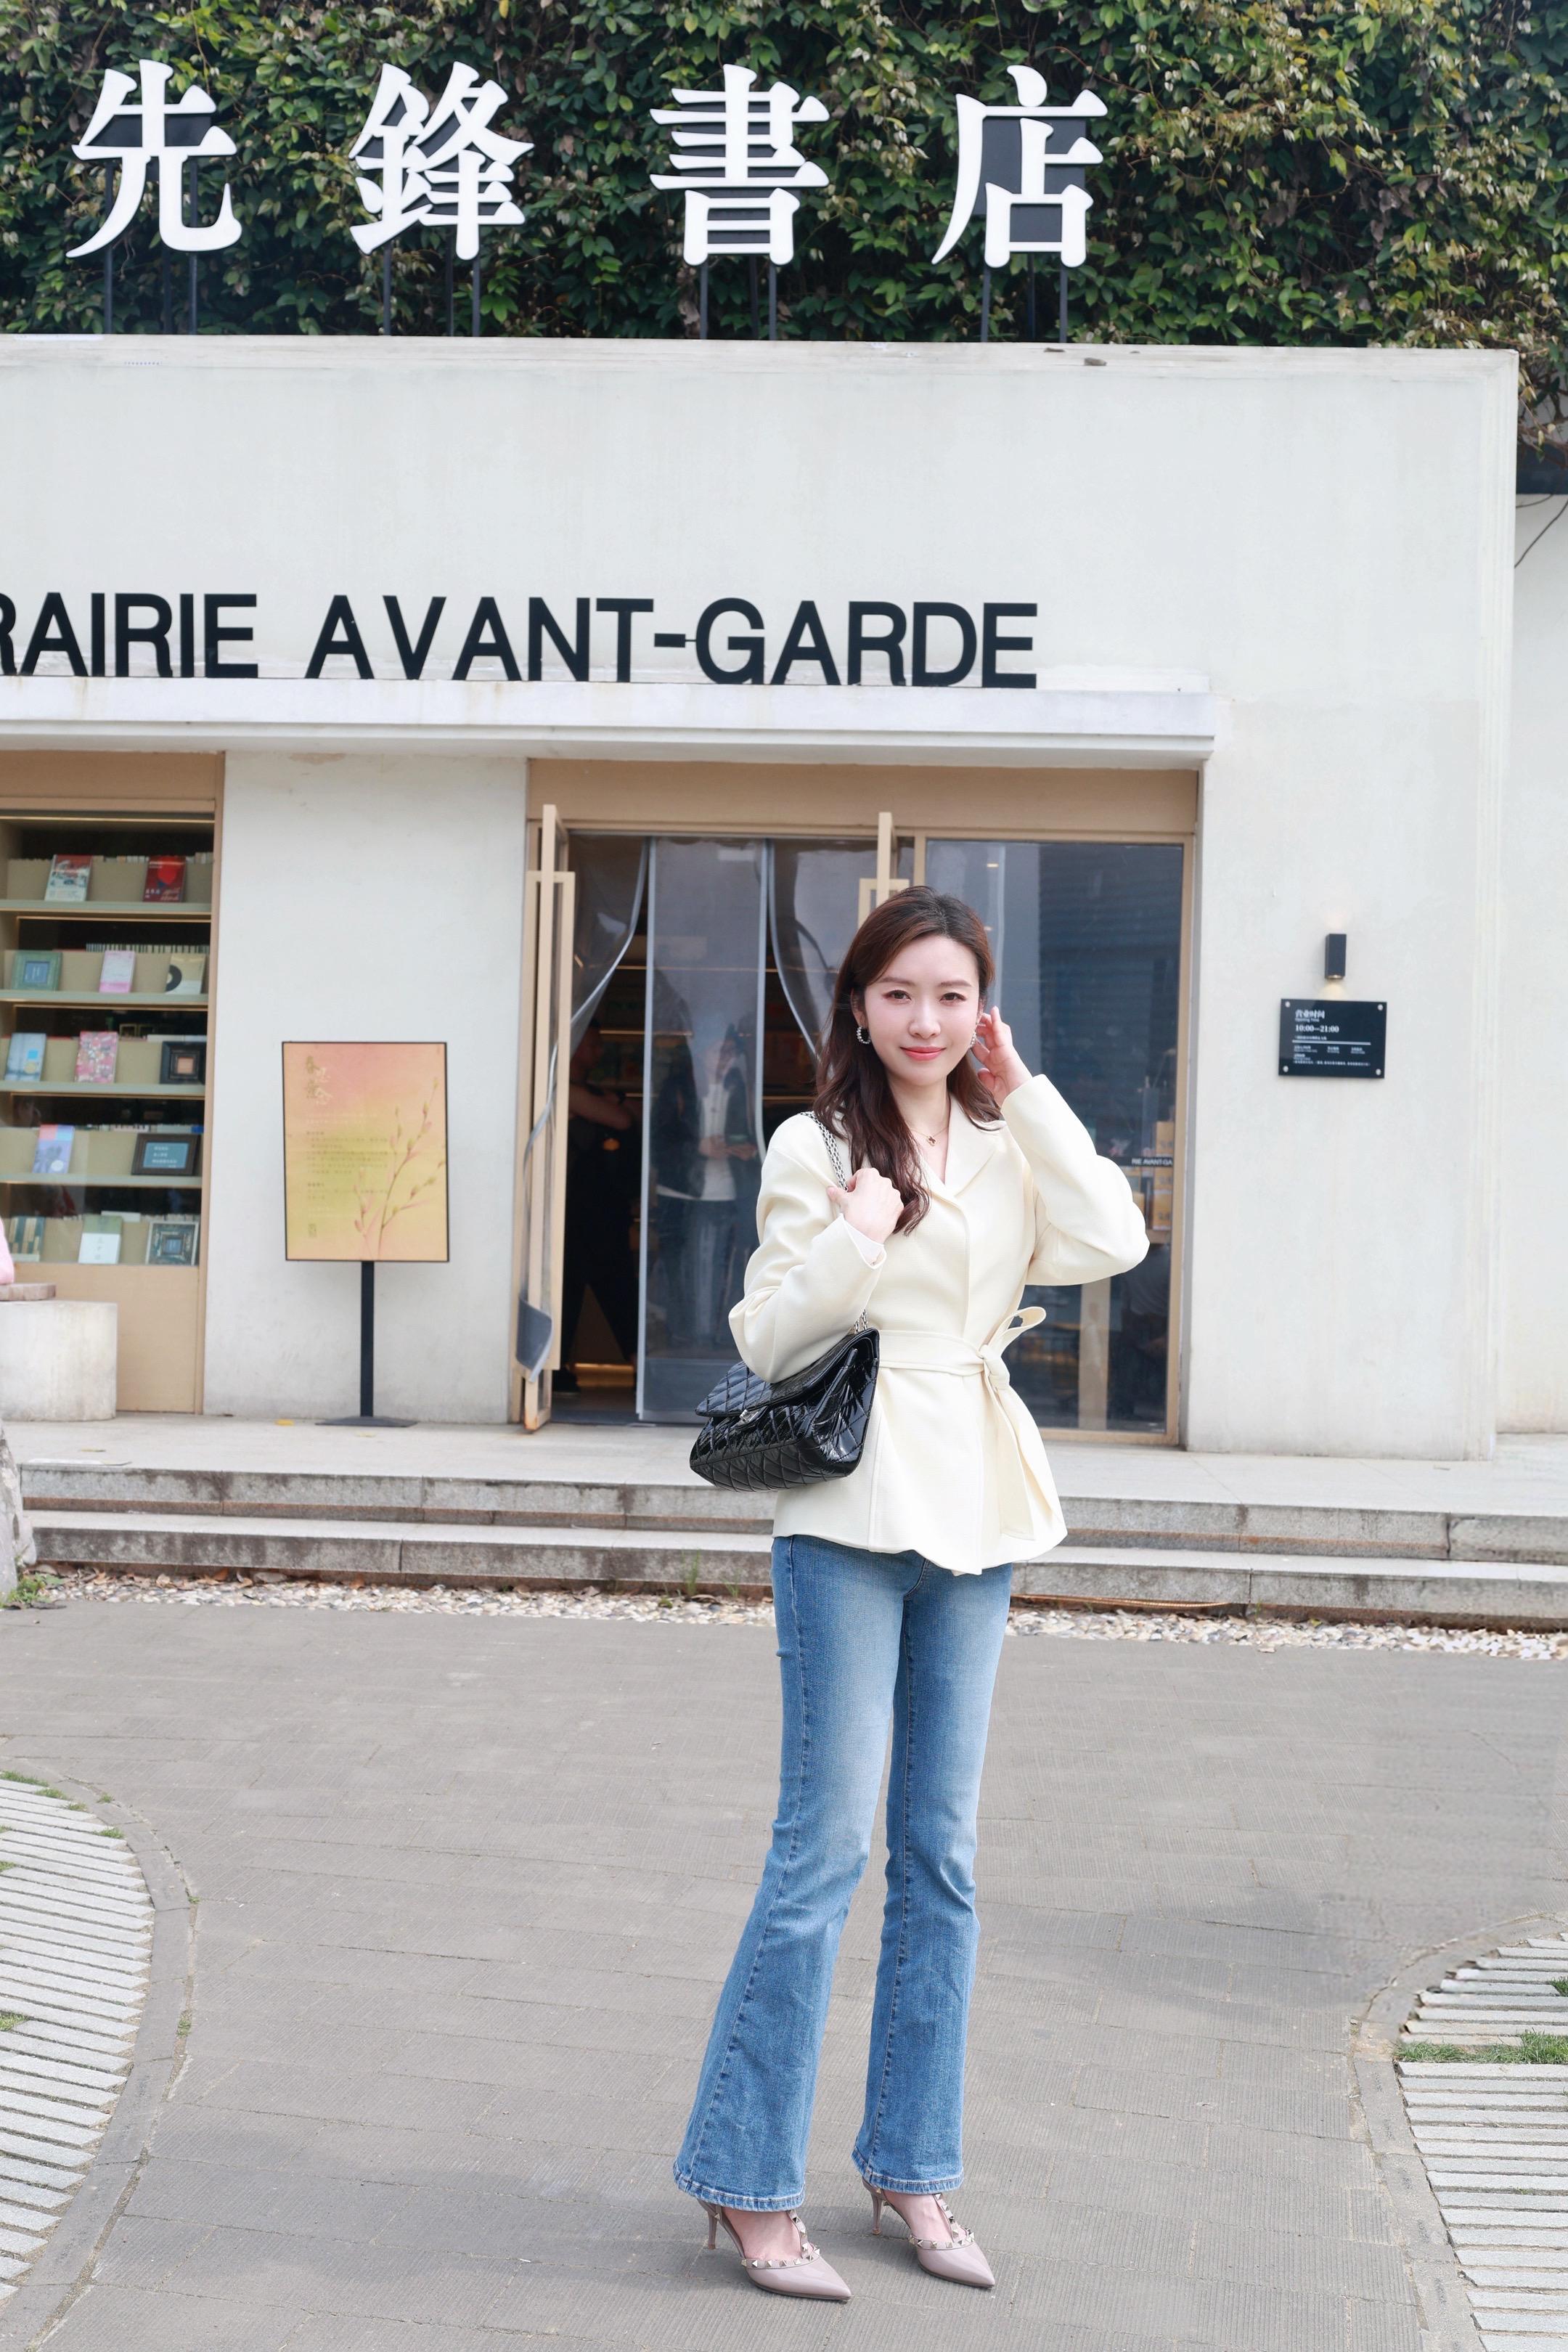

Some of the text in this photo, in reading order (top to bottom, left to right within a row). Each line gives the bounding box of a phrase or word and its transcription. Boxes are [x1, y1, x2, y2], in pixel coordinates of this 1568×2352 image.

[67, 60, 1108, 267] 先鋒書店
[304, 595, 1037, 689] AVANT-GARDE
[1295, 1009, 1326, 1019] 营业时间
